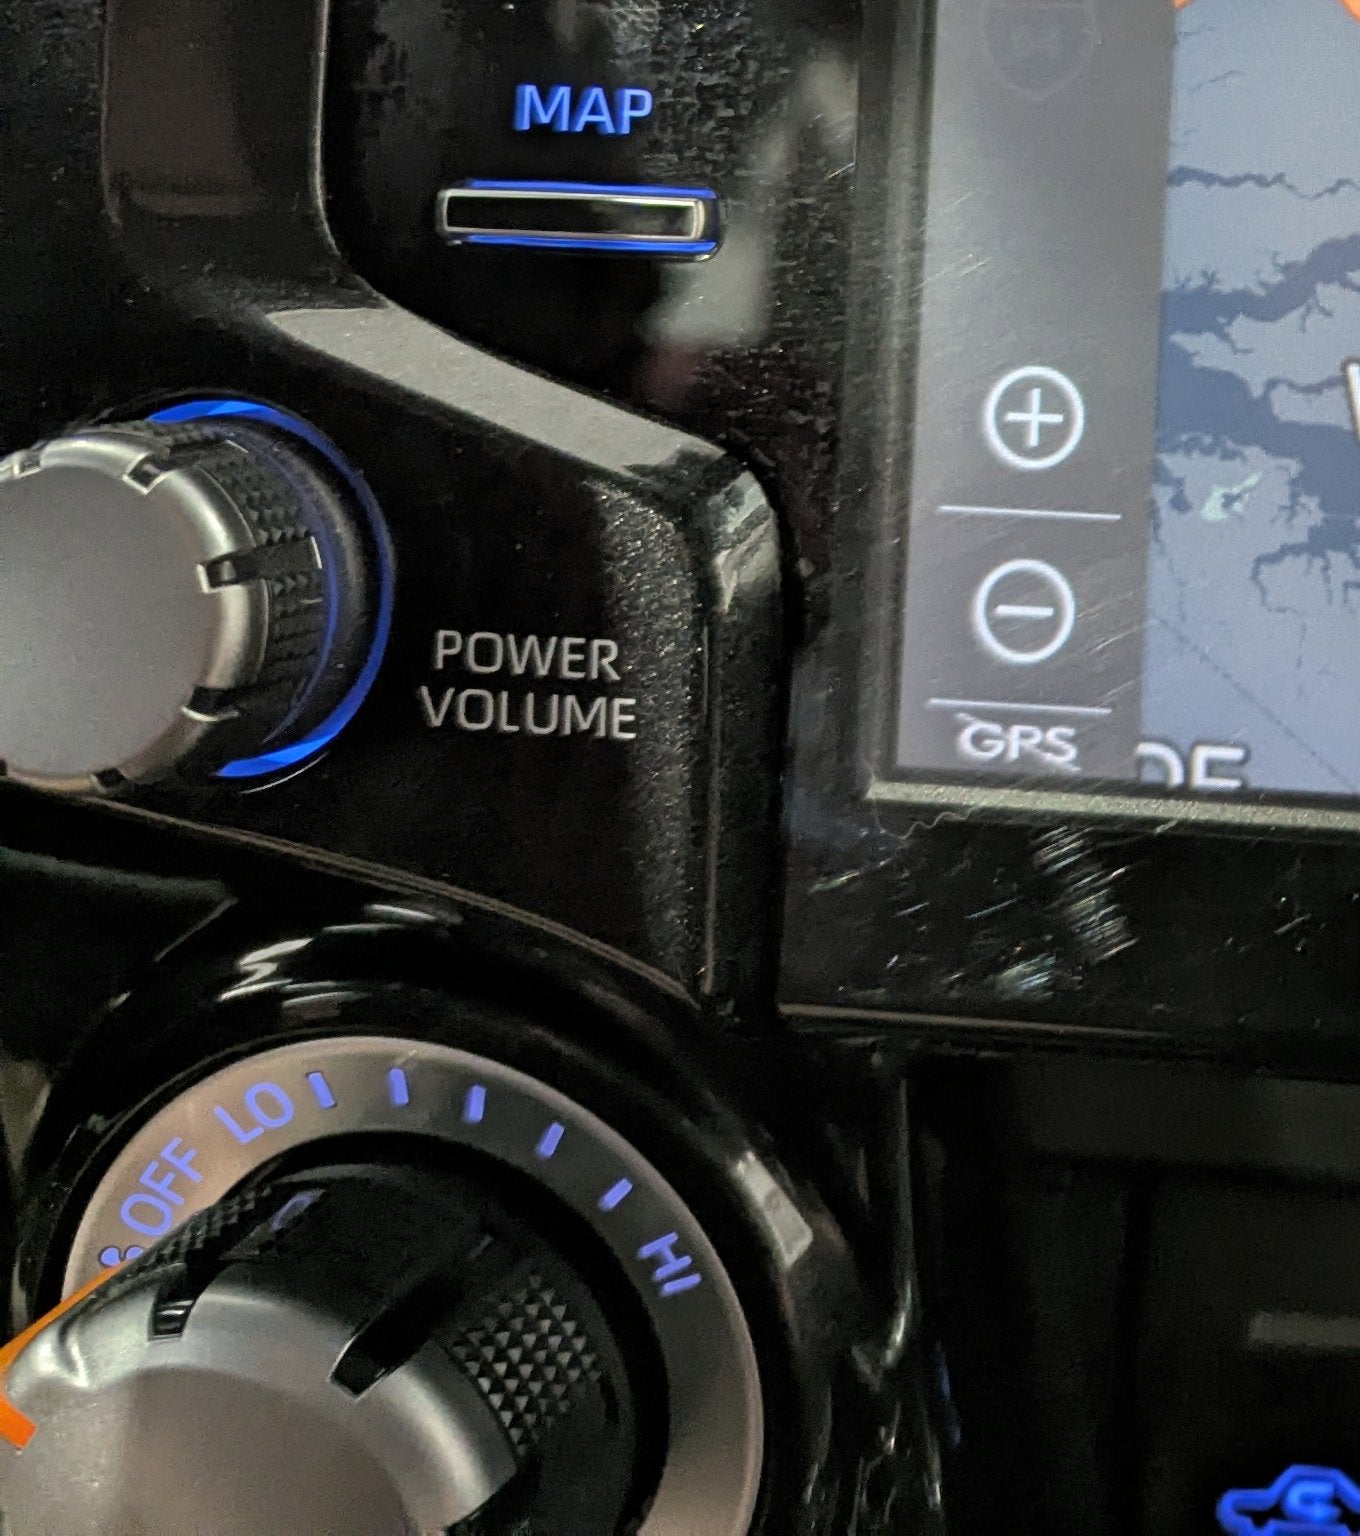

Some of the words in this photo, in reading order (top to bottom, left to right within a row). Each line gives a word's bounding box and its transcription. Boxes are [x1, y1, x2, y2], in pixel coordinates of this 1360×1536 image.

[513, 82, 654, 135] MAP
[432, 629, 621, 681] POWER
[415, 685, 637, 741] VOLUME
[955, 719, 1078, 766] GPS
[214, 1082, 295, 1146] LO
[119, 1136, 204, 1237] OFF
[636, 1231, 703, 1298] HI
